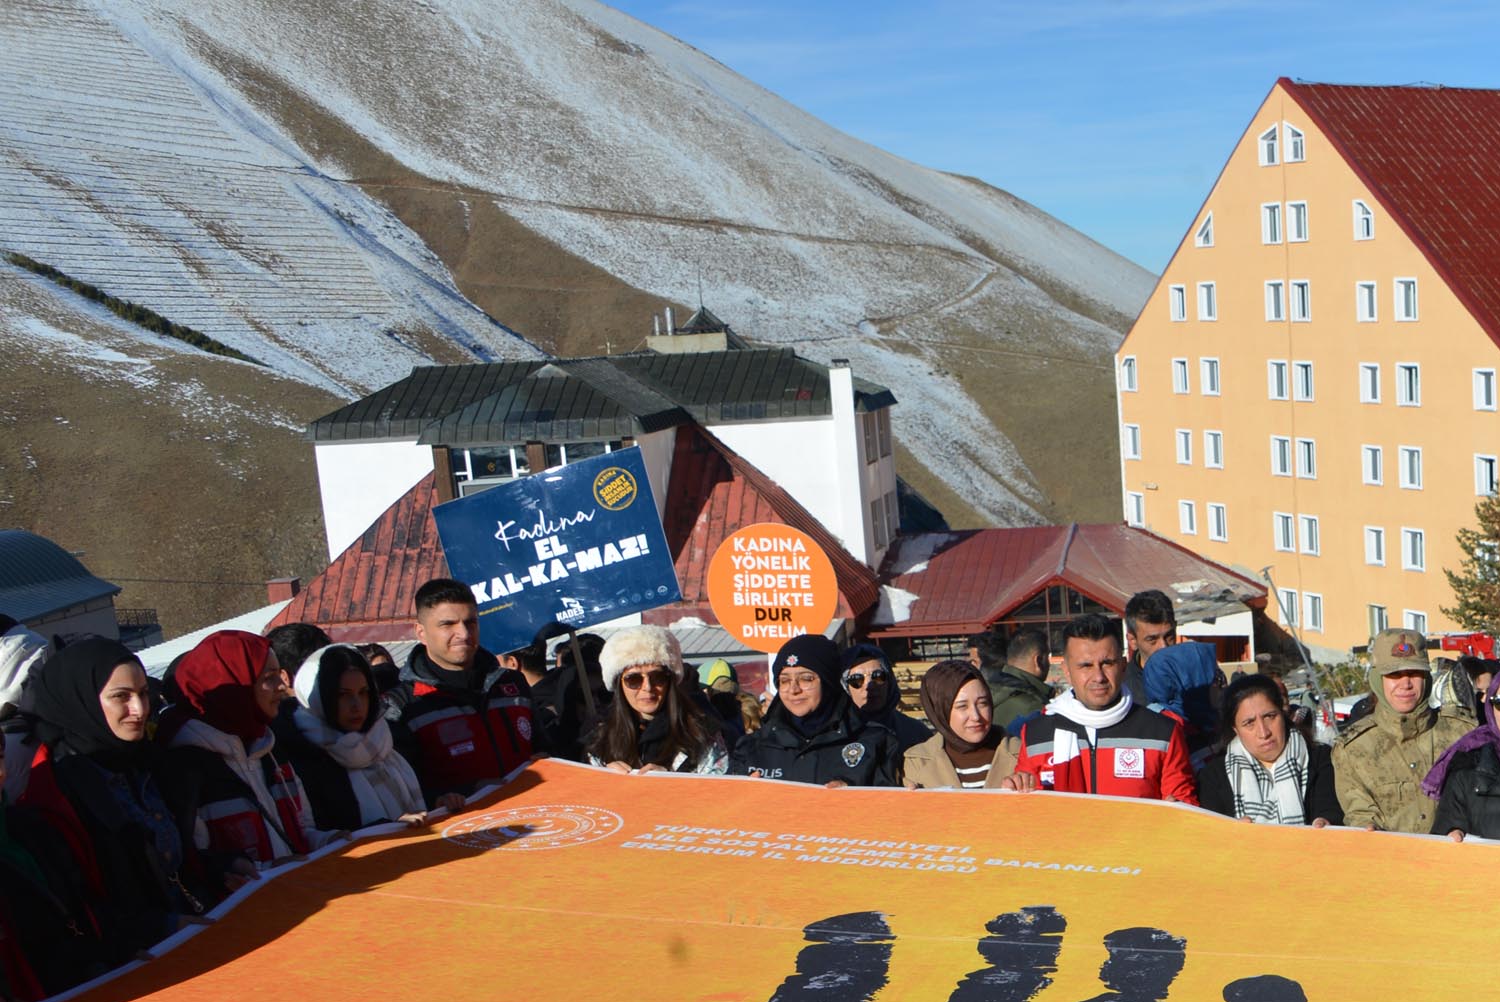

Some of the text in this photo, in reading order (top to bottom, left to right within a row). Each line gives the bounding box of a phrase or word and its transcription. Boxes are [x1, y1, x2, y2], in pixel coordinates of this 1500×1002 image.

[494, 509, 595, 552] Kadına
[534, 535, 568, 561] EL
[733, 537, 806, 552] KADINA
[470, 534, 650, 604] KAL-KA-MAZ!
[731, 552, 811, 570] YÖNELİK
[733, 570, 811, 591] ŞİDDETE
[733, 589, 814, 606] BİRLİKTE
[556, 607, 585, 622] KADES
[755, 608, 792, 622] DUR
[742, 622, 807, 638] DİYELİM
[654, 824, 771, 838] TÜRKİYE
[620, 841, 757, 857] ERZURUM
[633, 833, 1142, 875] AİLE SOSYAL HİZMETLER BAKANLIĞI
